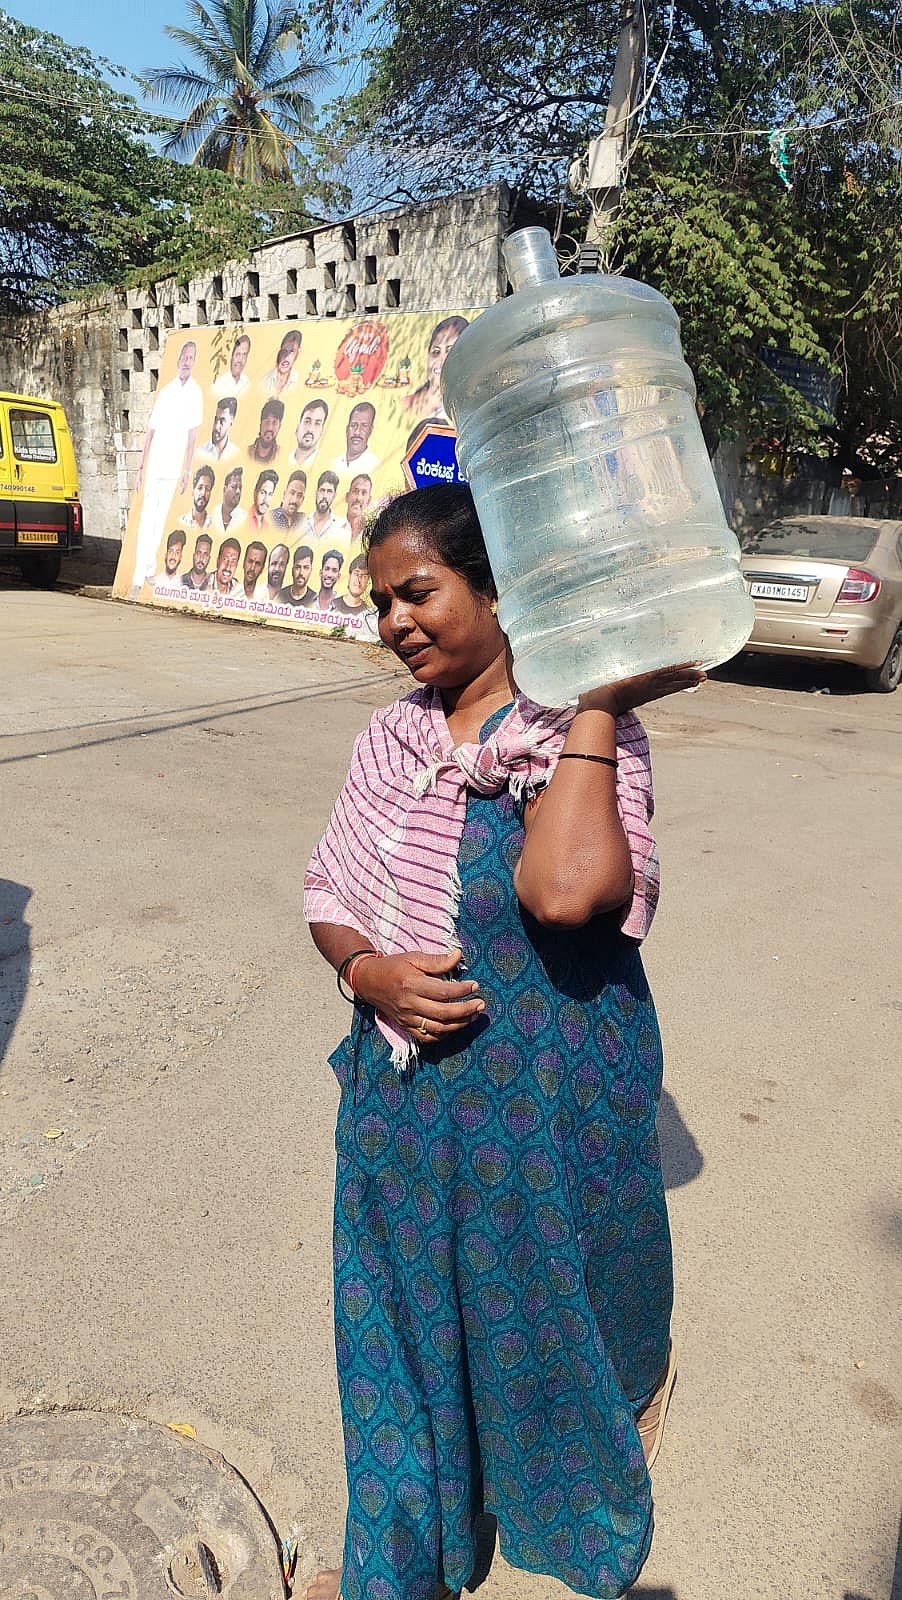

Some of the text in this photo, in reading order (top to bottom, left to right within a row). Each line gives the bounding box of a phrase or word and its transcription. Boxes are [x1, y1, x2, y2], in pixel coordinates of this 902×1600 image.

[154, 585, 188, 600] ಯುಗಾದಿ
[189, 591, 210, 607] ಮತ್ತು
[248, 601, 292, 617] ನವಮಿಯ
[756, 584, 807, 598] KA01MG1451
